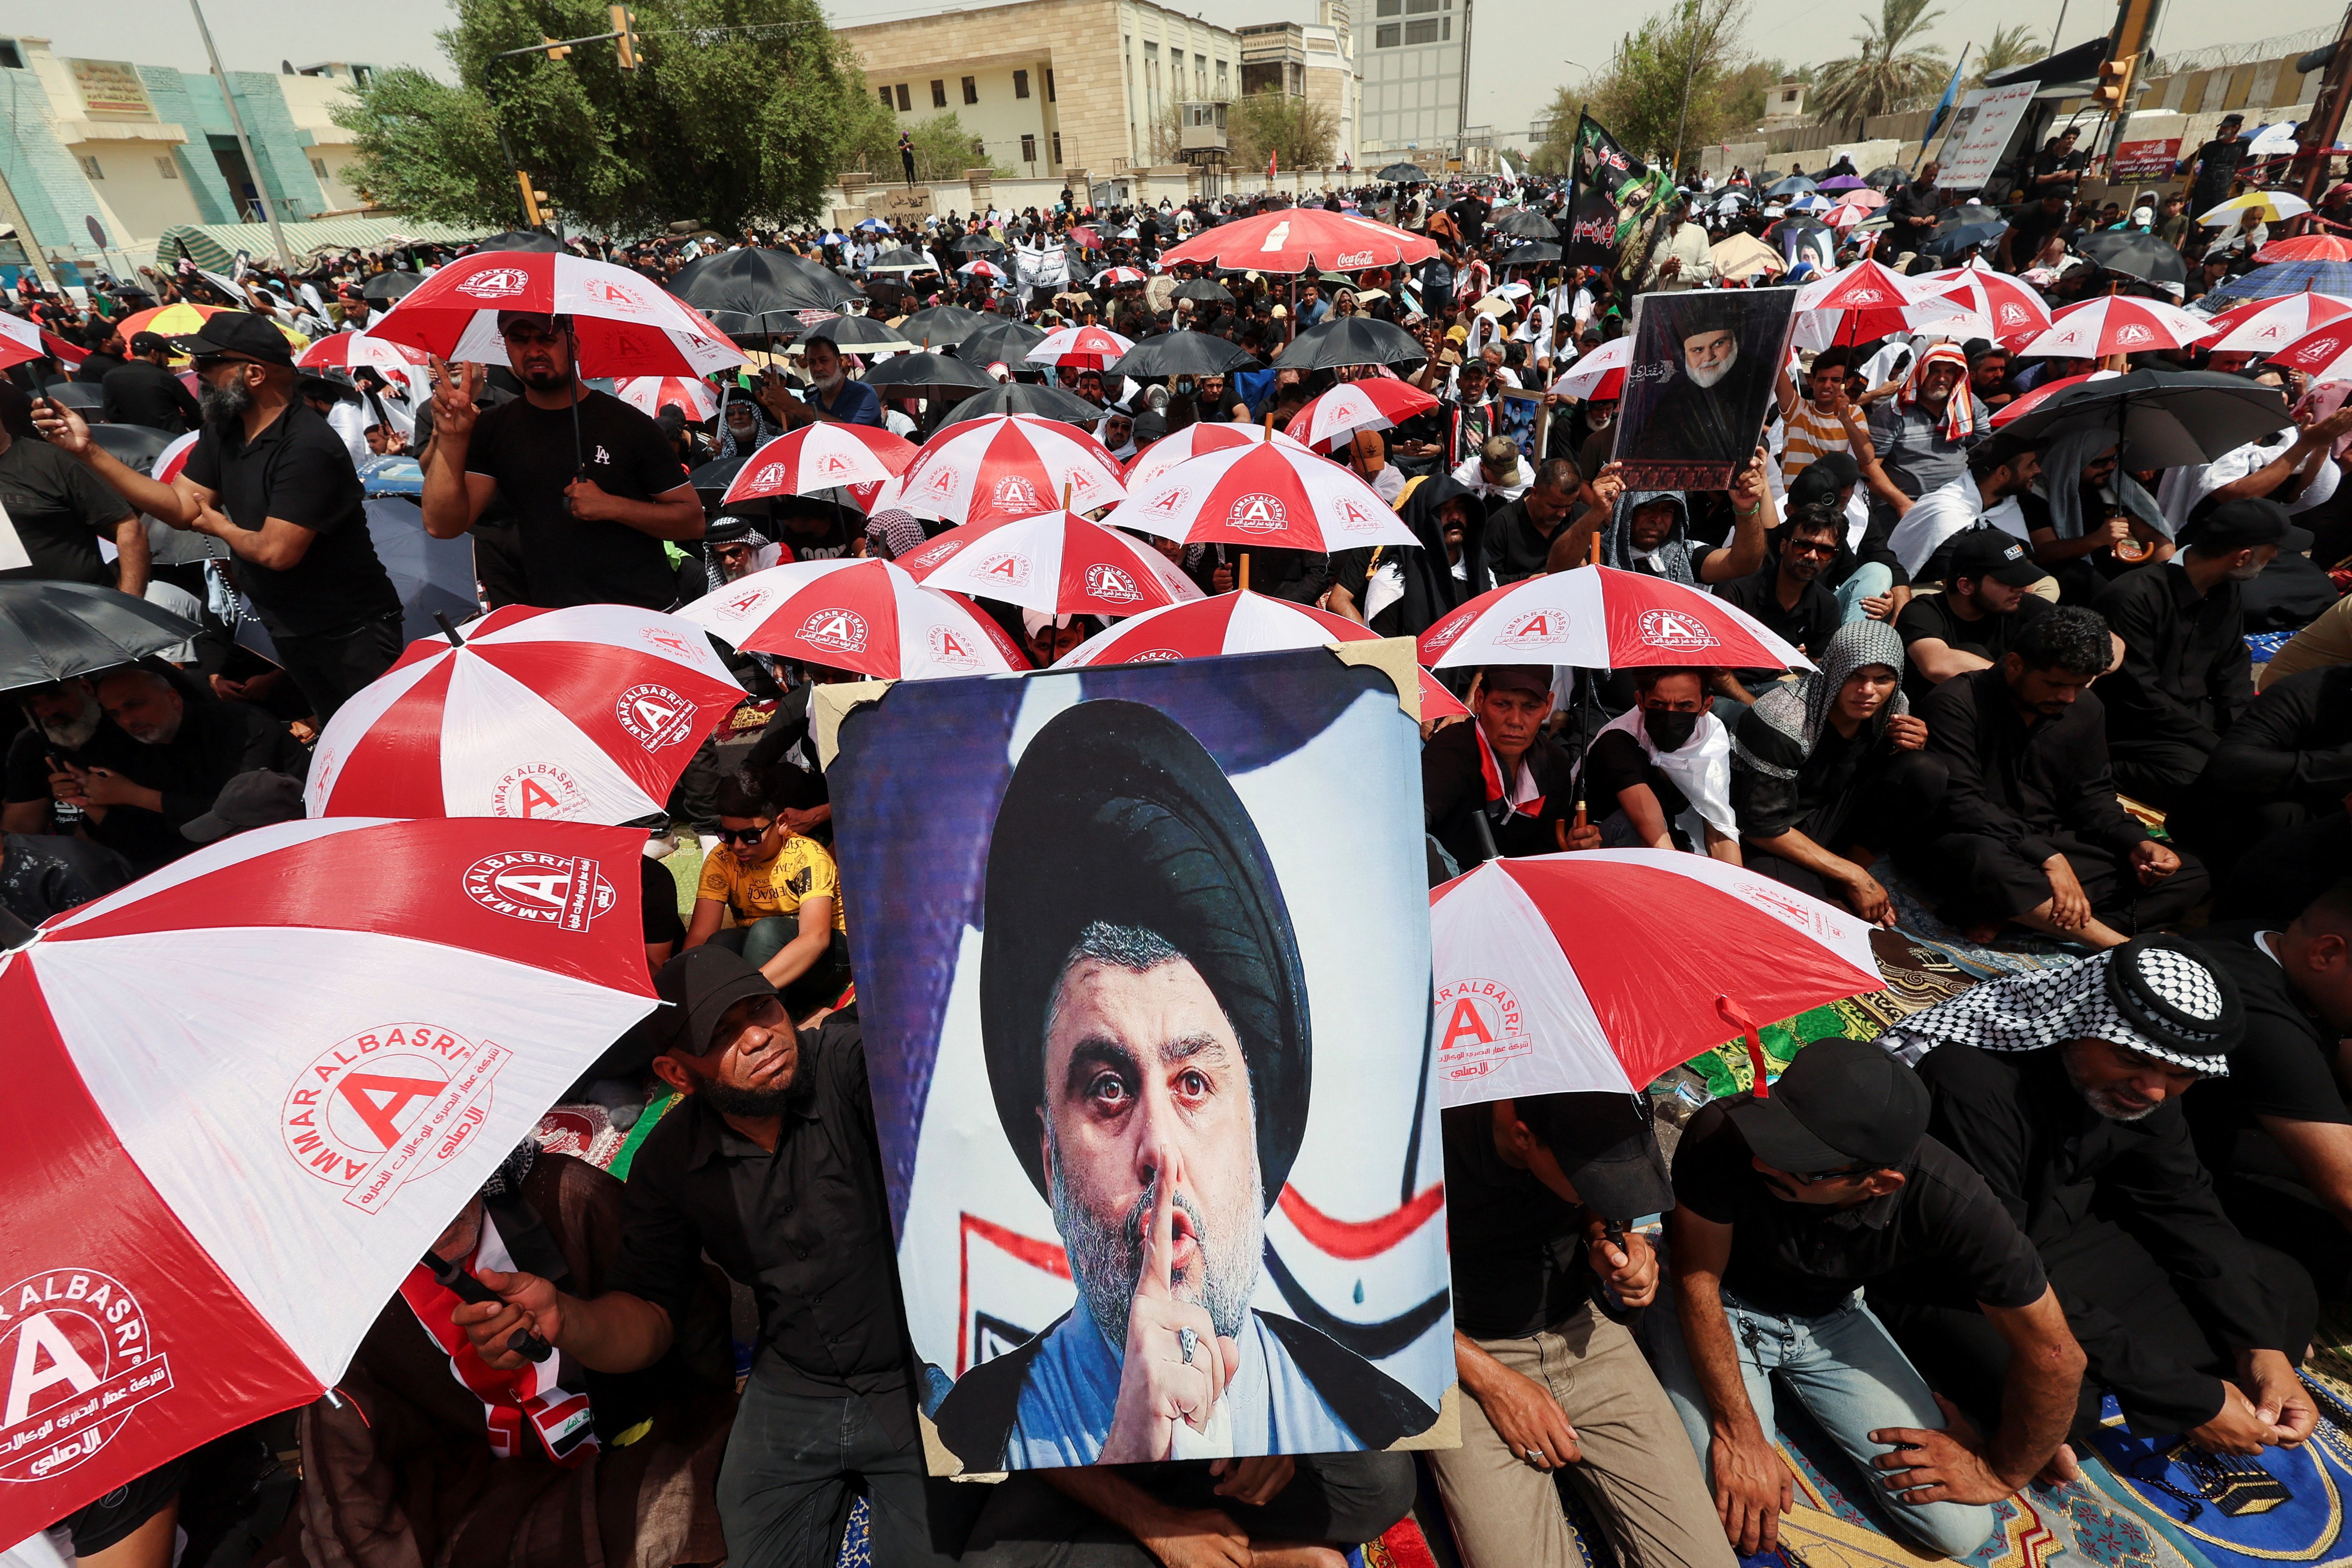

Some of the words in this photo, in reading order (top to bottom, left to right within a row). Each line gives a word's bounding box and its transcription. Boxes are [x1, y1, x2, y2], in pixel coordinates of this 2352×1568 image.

[1337, 250, 1374, 267] Coca-Cola
[467, 269, 500, 286] AMMAR
[504, 269, 529, 289] ALBASRI
[483, 274, 508, 288] A
[584, 279, 600, 297] AMMAR
[603, 280, 645, 305] ALBASRI
[606, 285, 632, 303] A
[1854, 292, 1871, 301] A
[2007, 307, 2021, 320] A
[2060, 332, 2076, 343] A
[2126, 328, 2142, 340] A
[2261, 327, 2277, 337] A
[1598, 351, 1613, 362] A
[2308, 343, 2330, 357] A
[635, 394, 643, 403] A
[1337, 406, 1351, 419] A
[595, 445, 610, 465] LA
[817, 454, 830, 472] AMMAR
[829, 454, 855, 470] ALBASRI
[829, 458, 845, 472] A
[755, 463, 774, 482] AMMAR
[773, 462, 784, 481] ALBASRI
[762, 468, 778, 483] A
[928, 466, 948, 485] AMMAR
[948, 466, 959, 493] ALBASRI
[934, 472, 949, 492] A
[1073, 472, 1091, 490] A
[995, 478, 1011, 499] AMMAR
[1011, 477, 1034, 501] ALBASRI
[1006, 483, 1025, 501] A
[1151, 487, 1179, 505] AMMAR
[1179, 487, 1189, 511] ALBASRI
[1155, 492, 1179, 511] A
[1234, 495, 1256, 517] AMMAR
[1258, 495, 1282, 521] ALBASRI
[1244, 501, 1271, 520] A
[1345, 502, 1368, 522] A
[928, 546, 954, 560] A
[981, 554, 1009, 570] AMMAR
[1011, 555, 1029, 578] ALBASRI
[990, 558, 1014, 578] A
[1088, 566, 1103, 588] AMMAR
[1105, 566, 1134, 592] ALBASRI
[1102, 571, 1126, 592] A
[728, 588, 762, 604] AMMAR
[747, 589, 770, 613] ALBASRI
[731, 594, 761, 611] A
[807, 611, 839, 630] AMMAR
[841, 611, 865, 642] ALBASRI
[818, 617, 848, 641] A
[1439, 619, 1466, 638] A
[1506, 611, 1537, 634] AMMAR
[1540, 610, 1566, 634] ALBASRI
[1518, 616, 1548, 636] A
[1644, 612, 1661, 635] AMMAR
[1662, 611, 1705, 637] ALBASRI
[1662, 617, 1695, 638] A
[643, 627, 676, 639] ALBASRI
[930, 627, 943, 652] AMMAR
[944, 627, 975, 656] ALBASRI
[647, 639, 691, 659] AMMAR
[653, 637, 689, 653] A
[944, 633, 967, 656] A
[626, 686, 681, 705] ALBASRI
[620, 702, 650, 739] AMMAR
[635, 700, 676, 732] A
[495, 775, 516, 817] MMAR
[518, 764, 576, 795] ALBASRI
[521, 777, 560, 819] A
[469, 853, 565, 883] ALBASRI
[496, 874, 570, 907] A
[470, 884, 558, 921] AMMAR
[1458, 981, 1519, 1031] ALBASRI
[1441, 997, 1494, 1050] A
[314, 1028, 467, 1083] ALBASRI
[1466, 1048, 1491, 1057] البصري
[1492, 1045, 1507, 1055] عمار
[1508, 1040, 1529, 1051] شركة
[476, 1048, 500, 1075] شركة
[1451, 1061, 1489, 1079] الاصلي
[458, 1074, 479, 1094] عمار
[337, 1072, 450, 1150] A
[432, 1092, 461, 1125] البصري
[289, 1089, 369, 1180] AMMAR
[436, 1106, 485, 1160] الاصلي
[392, 1124, 434, 1171] للوكالات
[358, 1170, 393, 1205] التجارية
[19, 1274, 144, 1358] ALBASRI
[3, 1312, 103, 1429] A
[129, 1367, 166, 1393] شركة
[102, 1386, 128, 1410] عمار
[56, 1397, 99, 1429] البصري
[30, 1426, 102, 1476] الاصلي
